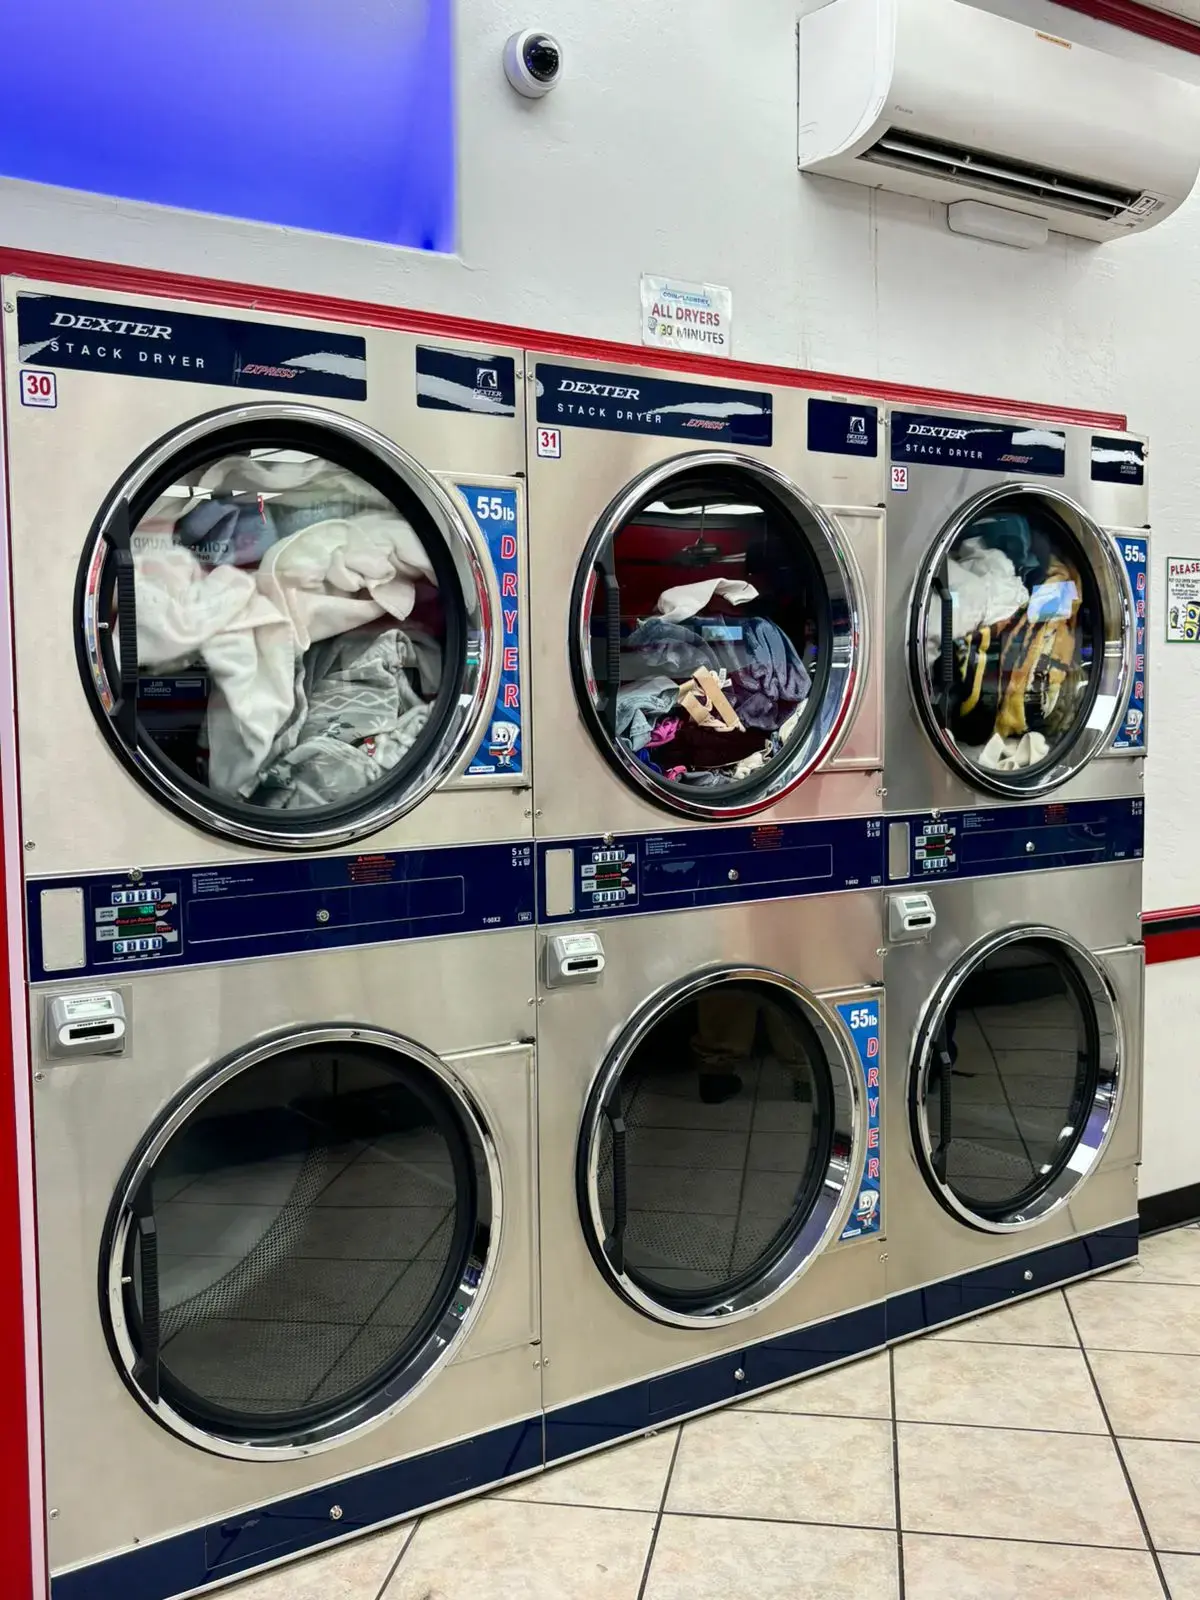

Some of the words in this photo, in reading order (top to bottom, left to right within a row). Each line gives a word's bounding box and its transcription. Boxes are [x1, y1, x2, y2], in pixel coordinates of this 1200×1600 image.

[651, 302, 673, 320] ALL
[675, 307, 720, 327] DRYERS
[50, 312, 172, 340] DEXTER
[661, 323, 673, 336] 30
[676, 326, 724, 345] MINUTES
[50, 341, 122, 359] STACK
[139, 351, 205, 369] DRYER
[242, 364, 299, 379] EXPRESS
[27, 375, 51, 396] 30
[557, 379, 640, 401] DEXTER
[557, 403, 606, 418] STACK
[616, 410, 662, 424] DRYER
[541, 431, 557, 448] 31
[906, 423, 968, 441] DEXTER
[905, 443, 942, 456] STACK
[948, 448, 984, 460] DRYER
[893, 468, 906, 483] 32
[476, 496, 516, 522] 55lb
[1169, 562, 1200, 577] PLEASE
[500, 535, 519, 708] DRYER
[1134, 572, 1146, 699] DRYER
[849, 1008, 878, 1029] 55lb
[866, 1036, 879, 1179] DRYER
